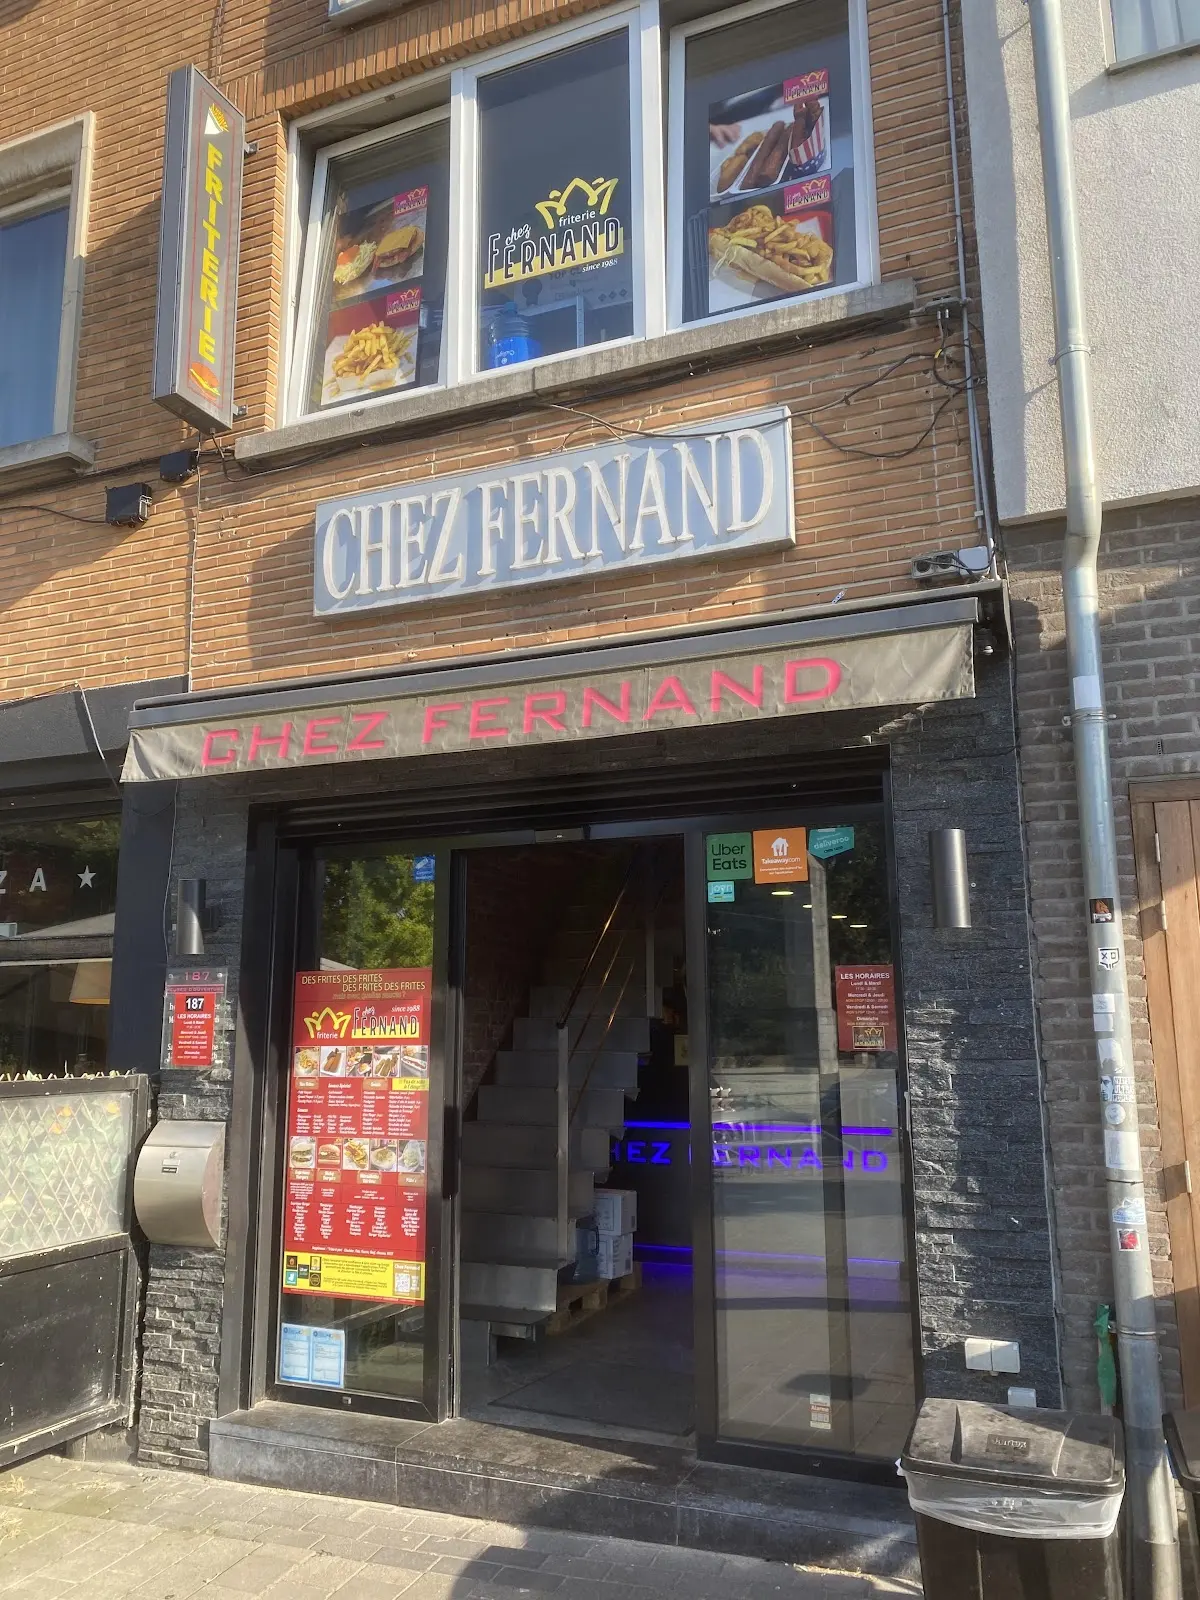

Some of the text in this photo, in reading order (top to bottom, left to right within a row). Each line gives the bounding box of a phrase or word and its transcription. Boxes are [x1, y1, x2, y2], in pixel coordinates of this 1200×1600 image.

[558, 209, 596, 227] friterie
[505, 223, 532, 246] chez
[199, 142, 223, 364] FRITERIE
[488, 217, 620, 283] FERNAND
[582, 257, 618, 273] since 1988
[322, 428, 775, 600] CHEZ FERNAND
[200, 657, 842, 767] CHEZ FERNAND
[711, 843, 745, 856] Uber
[712, 857, 747, 870] Eats
[761, 856, 801, 865] Takeaway.com
[184, 971, 210, 981] 187
[302, 973, 383, 985] DES FRITES DES FRITES
[855, 972, 890, 980] HORAIRES
[342, 981, 426, 992] DES FRITES DES FRITES
[186, 997, 205, 1010] 187
[406, 1005, 420, 1013] 1988
[362, 1006, 375, 1018] chez
[353, 1006, 418, 1036] FERNAND
[317, 1031, 338, 1039] friterie
